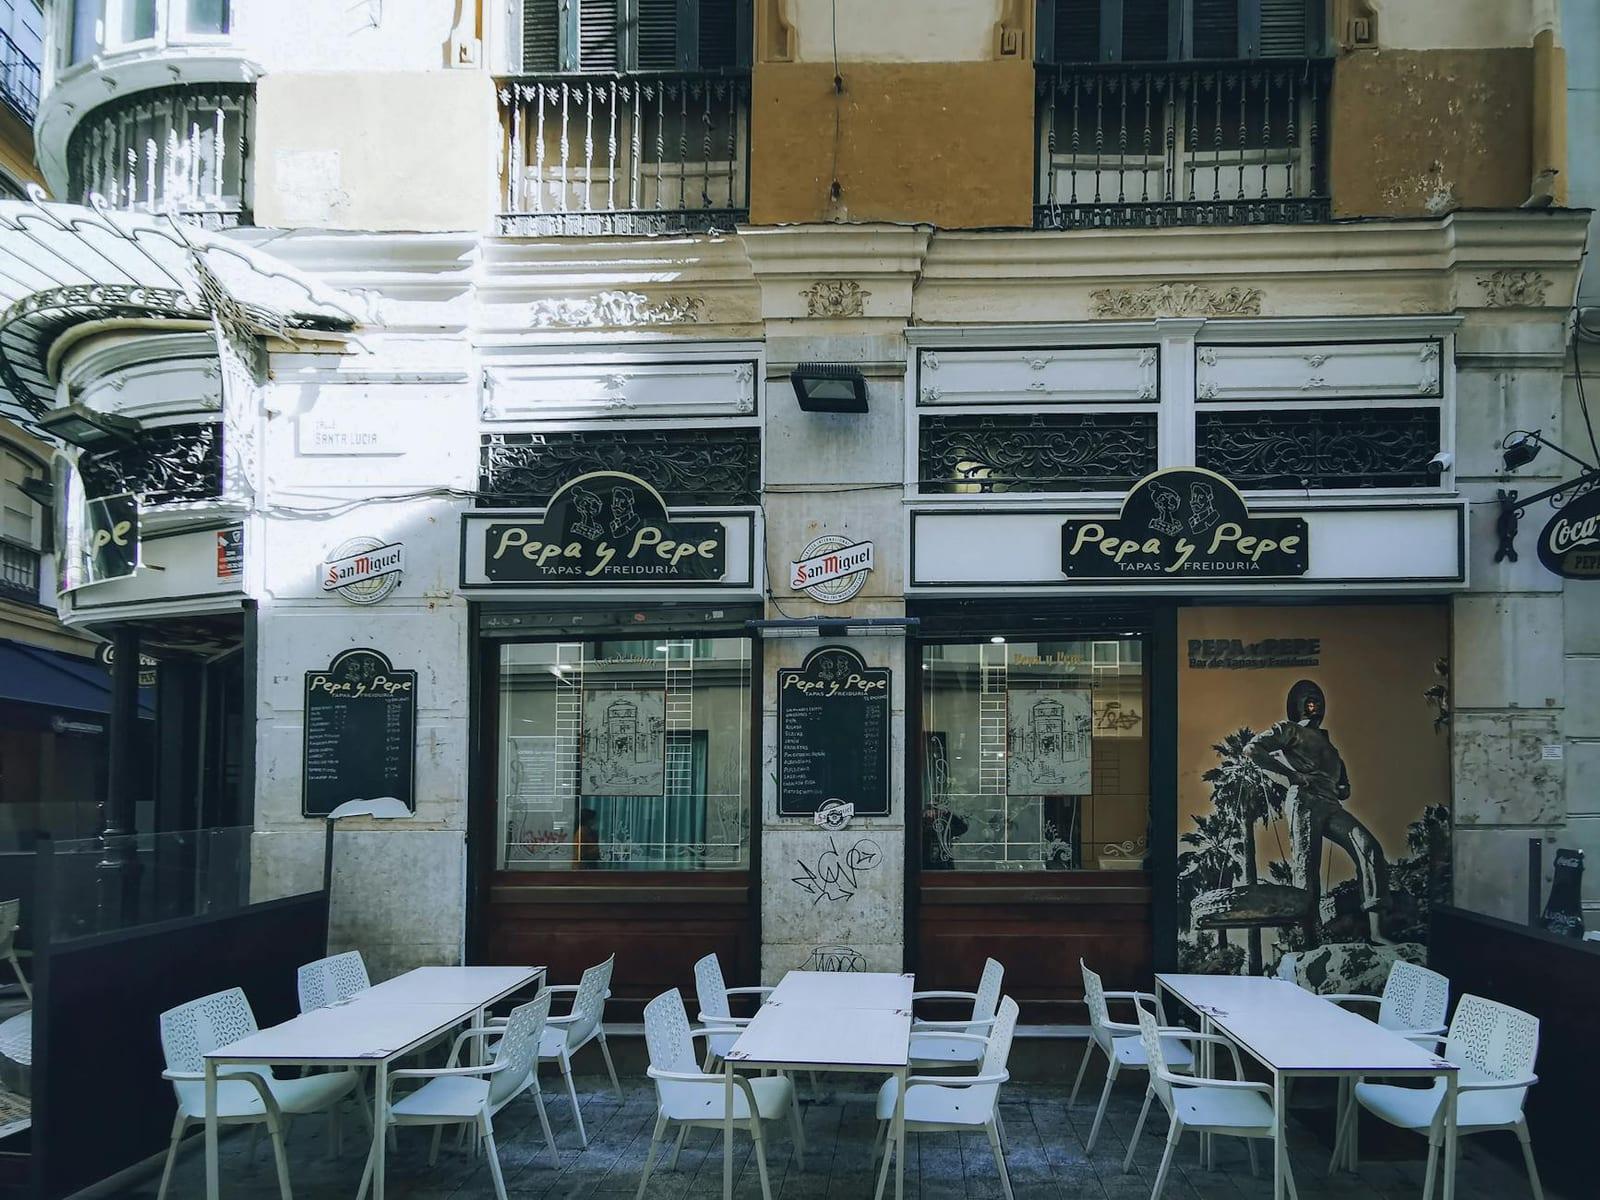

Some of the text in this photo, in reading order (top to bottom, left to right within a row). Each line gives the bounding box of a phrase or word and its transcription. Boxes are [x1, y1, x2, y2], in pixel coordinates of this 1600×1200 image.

[493, 526, 719, 577] Pepa y Pepe
[1069, 522, 1301, 573] Pepa y Pepe
[324, 565, 354, 587] San
[354, 549, 401, 575] Miguel
[541, 564, 679, 575] TAPAS FREIDURIA
[792, 564, 823, 587] San
[822, 547, 870, 574] Miguel
[1118, 560, 1260, 572] TAPAS FREIDURIA
[310, 675, 412, 698] Pepa y Pepe
[783, 674, 887, 697] Pepa y Pepe
